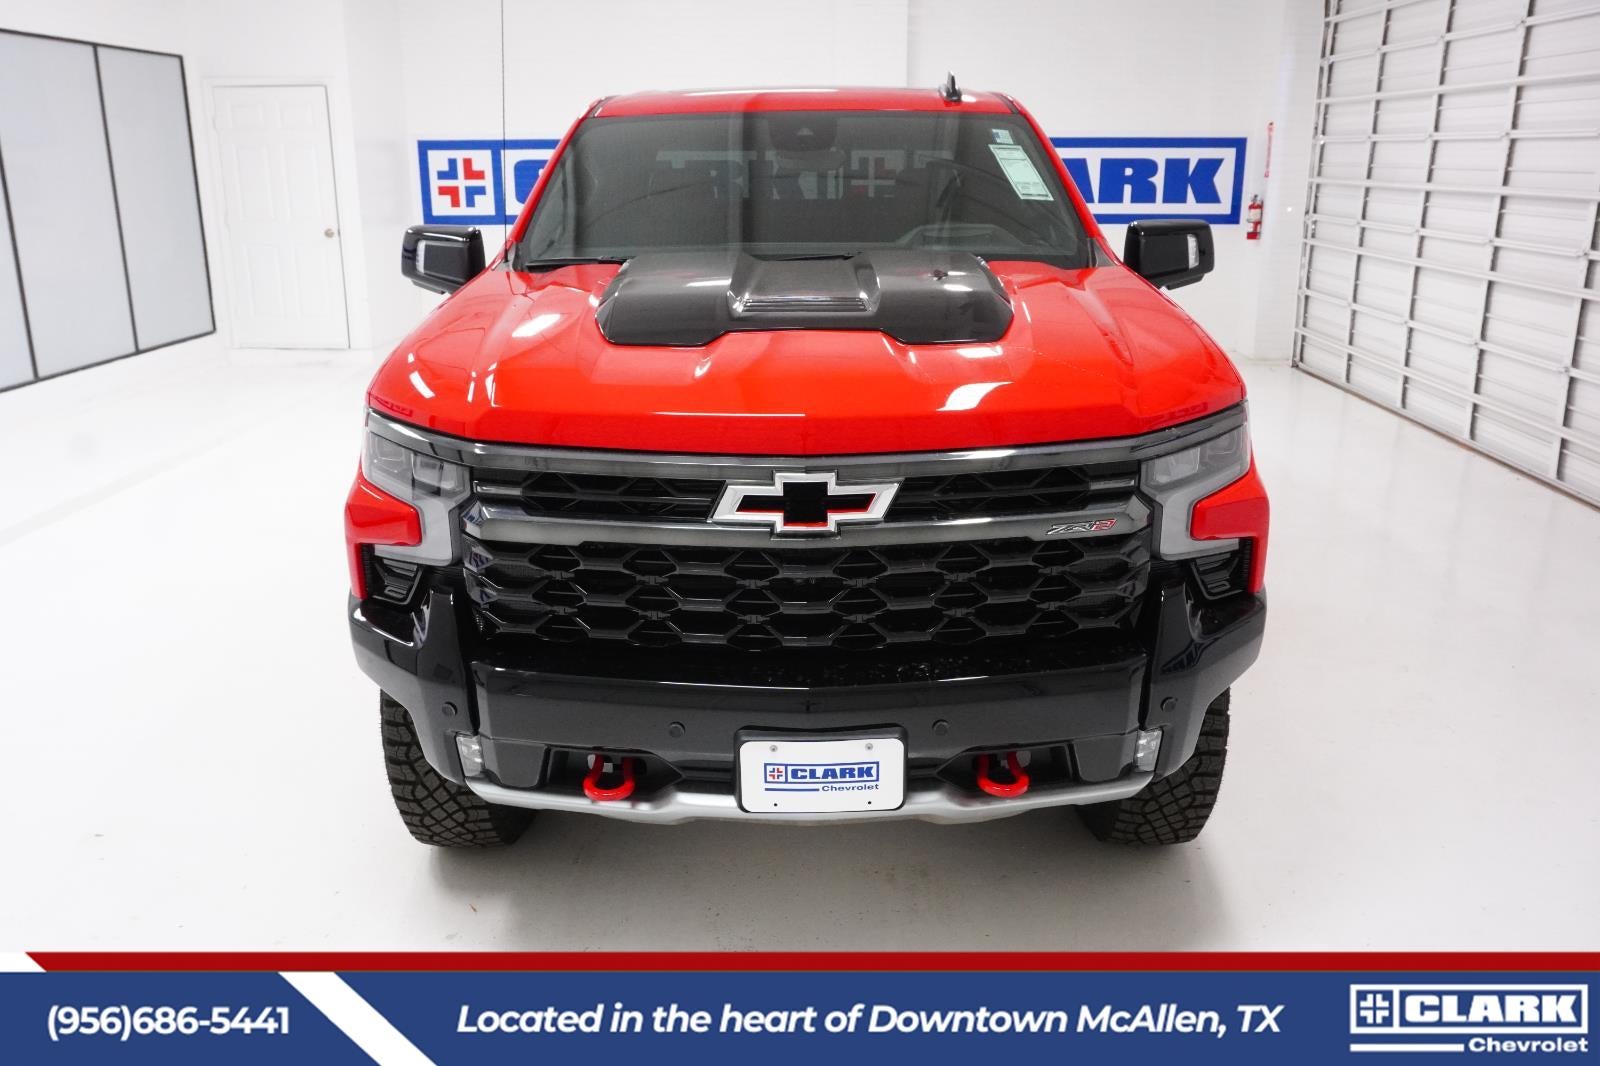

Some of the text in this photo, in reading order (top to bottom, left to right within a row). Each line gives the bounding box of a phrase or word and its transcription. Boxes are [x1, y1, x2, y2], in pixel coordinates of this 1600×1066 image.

[1047, 518, 1117, 534] ZR2
[791, 767, 874, 779] CLARK
[822, 784, 879, 792] Chevrolet
